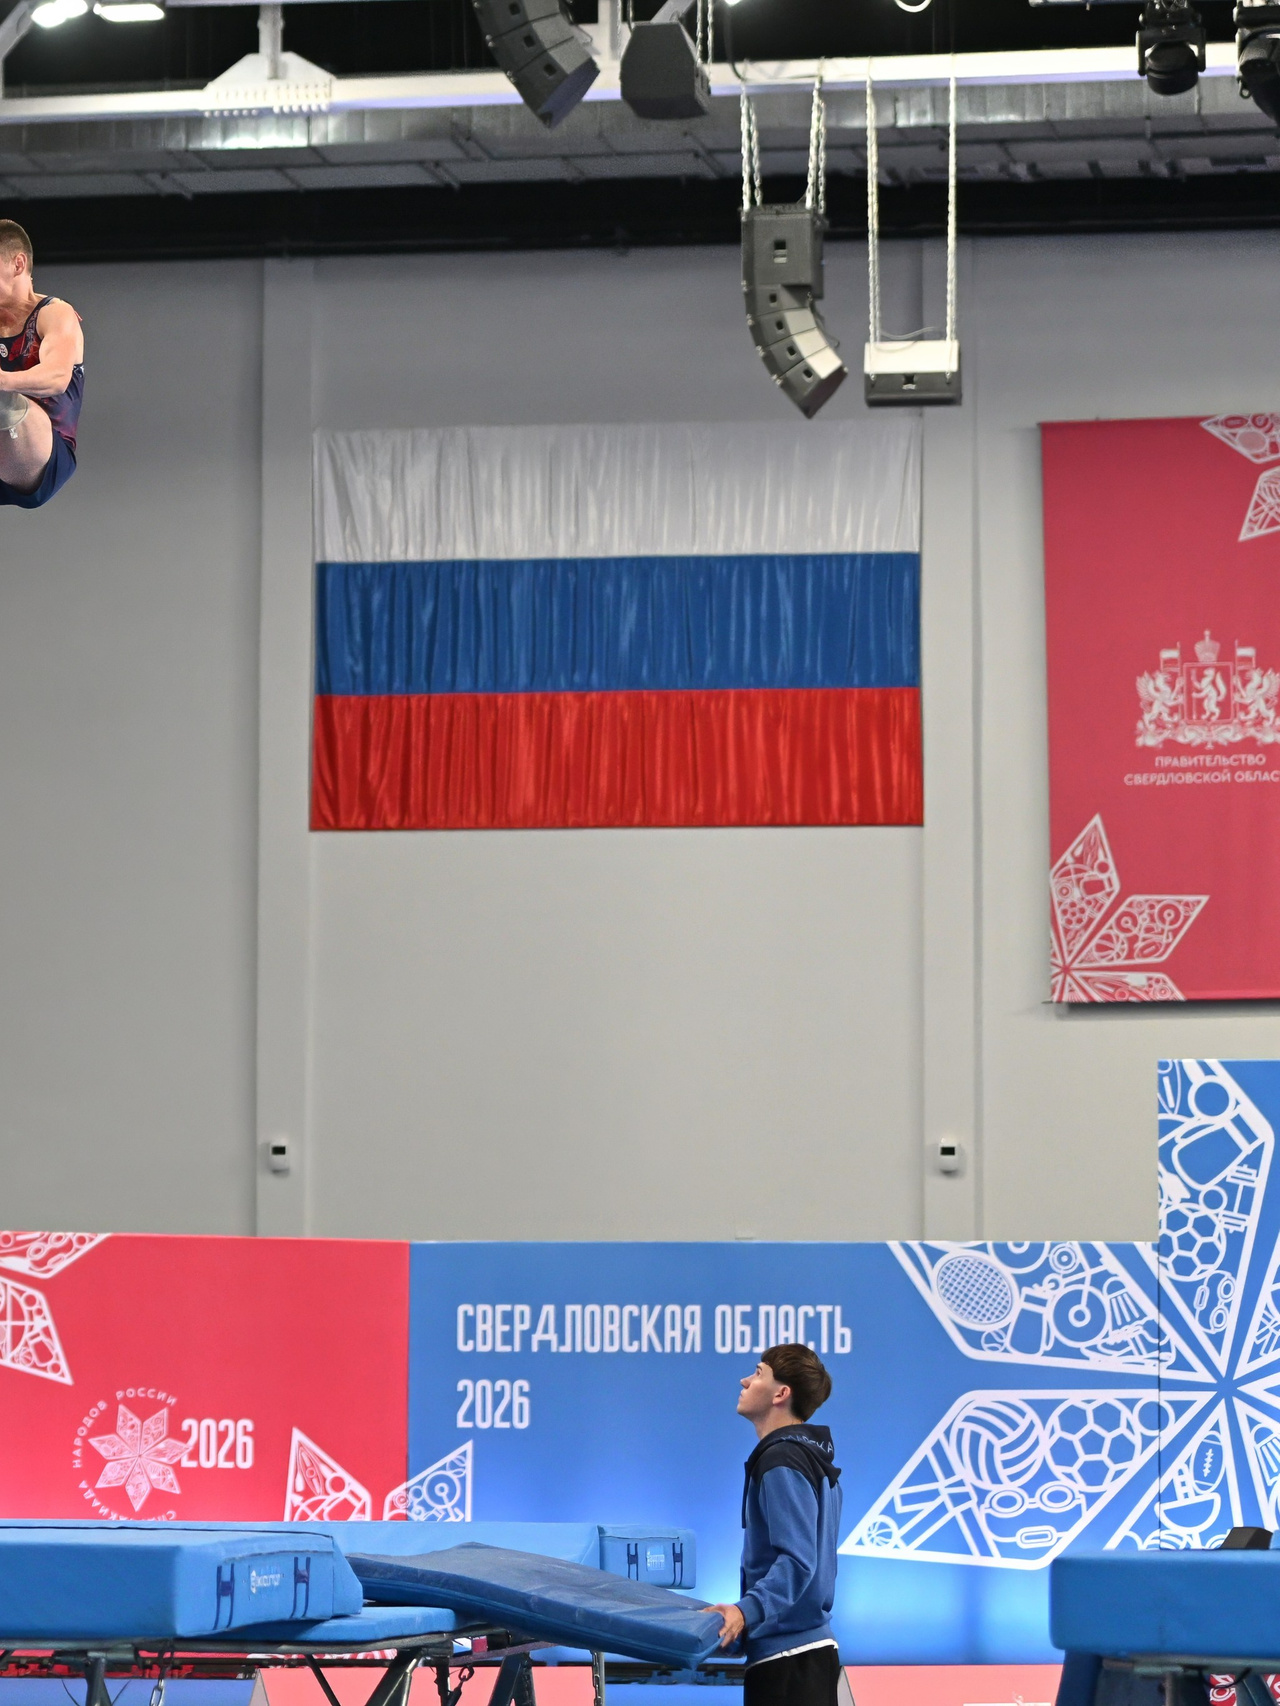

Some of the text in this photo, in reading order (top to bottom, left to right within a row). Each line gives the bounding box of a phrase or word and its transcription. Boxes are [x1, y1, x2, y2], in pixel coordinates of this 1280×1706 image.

[1123, 769, 1280, 786] СВЕРДЛОВСКОЙ ОБЛАС
[1154, 753, 1267, 768] ПРАВИТЕЛЬСТВО
[456, 1304, 852, 1354] СВЕРДЛОВСКАЯ ОБЛАСТЬ
[72, 1400, 108, 1468] НАРОДОВ
[116, 1387, 178, 1407] РОССИИ
[456, 1379, 531, 1429] 2026
[180, 1418, 255, 1469] 2026
